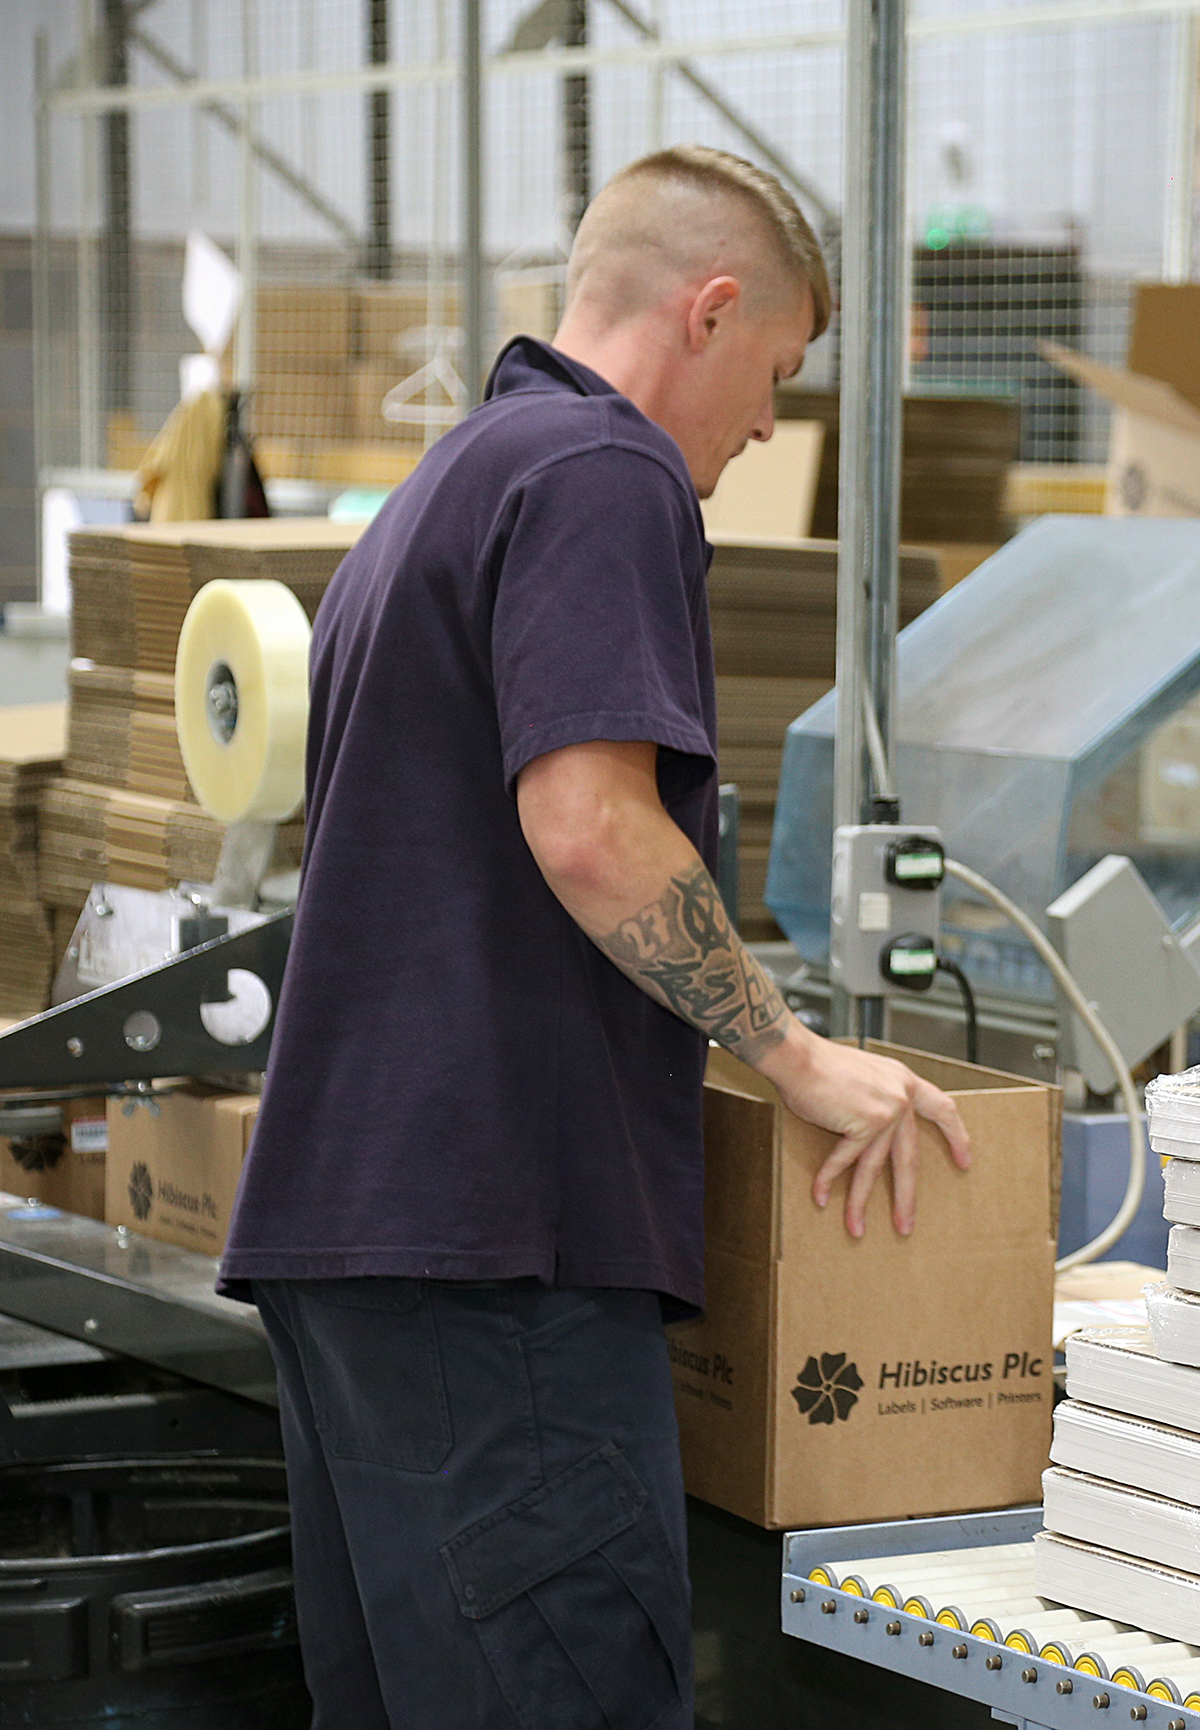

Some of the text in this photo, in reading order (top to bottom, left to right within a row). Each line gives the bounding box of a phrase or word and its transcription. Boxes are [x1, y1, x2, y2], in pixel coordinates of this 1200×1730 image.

[668, 1337, 734, 1385] biscus Plc
[878, 1351, 1042, 1390] Hibiscus Plc
[878, 1400, 917, 1416] Labels
[930, 1396, 983, 1412] Software
[998, 1391, 1042, 1405] Printers
